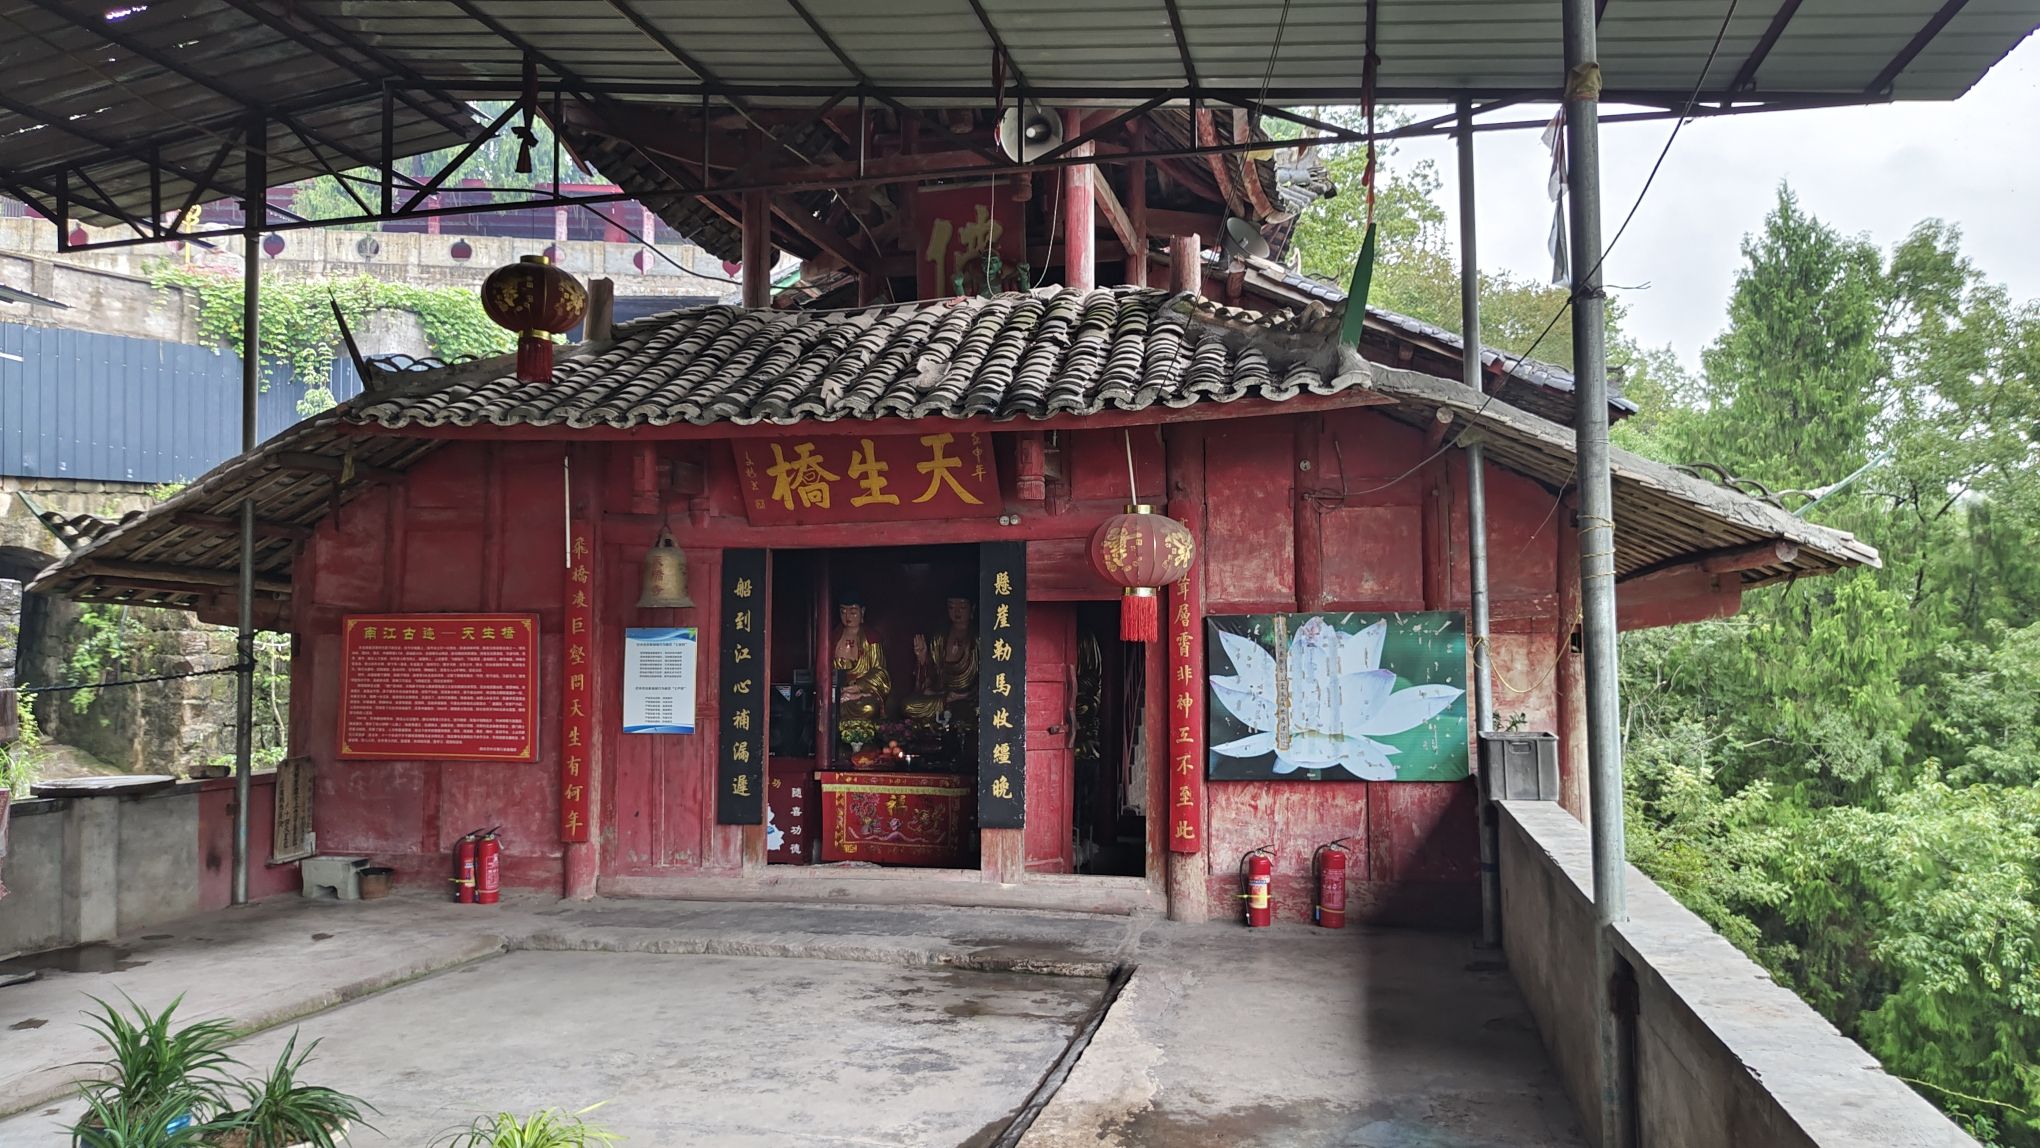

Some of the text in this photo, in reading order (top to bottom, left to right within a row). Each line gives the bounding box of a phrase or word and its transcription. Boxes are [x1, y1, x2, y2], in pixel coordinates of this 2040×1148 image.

[766, 433, 985, 510] 天生橋
[732, 577, 752, 797] 船到江心補漏遲
